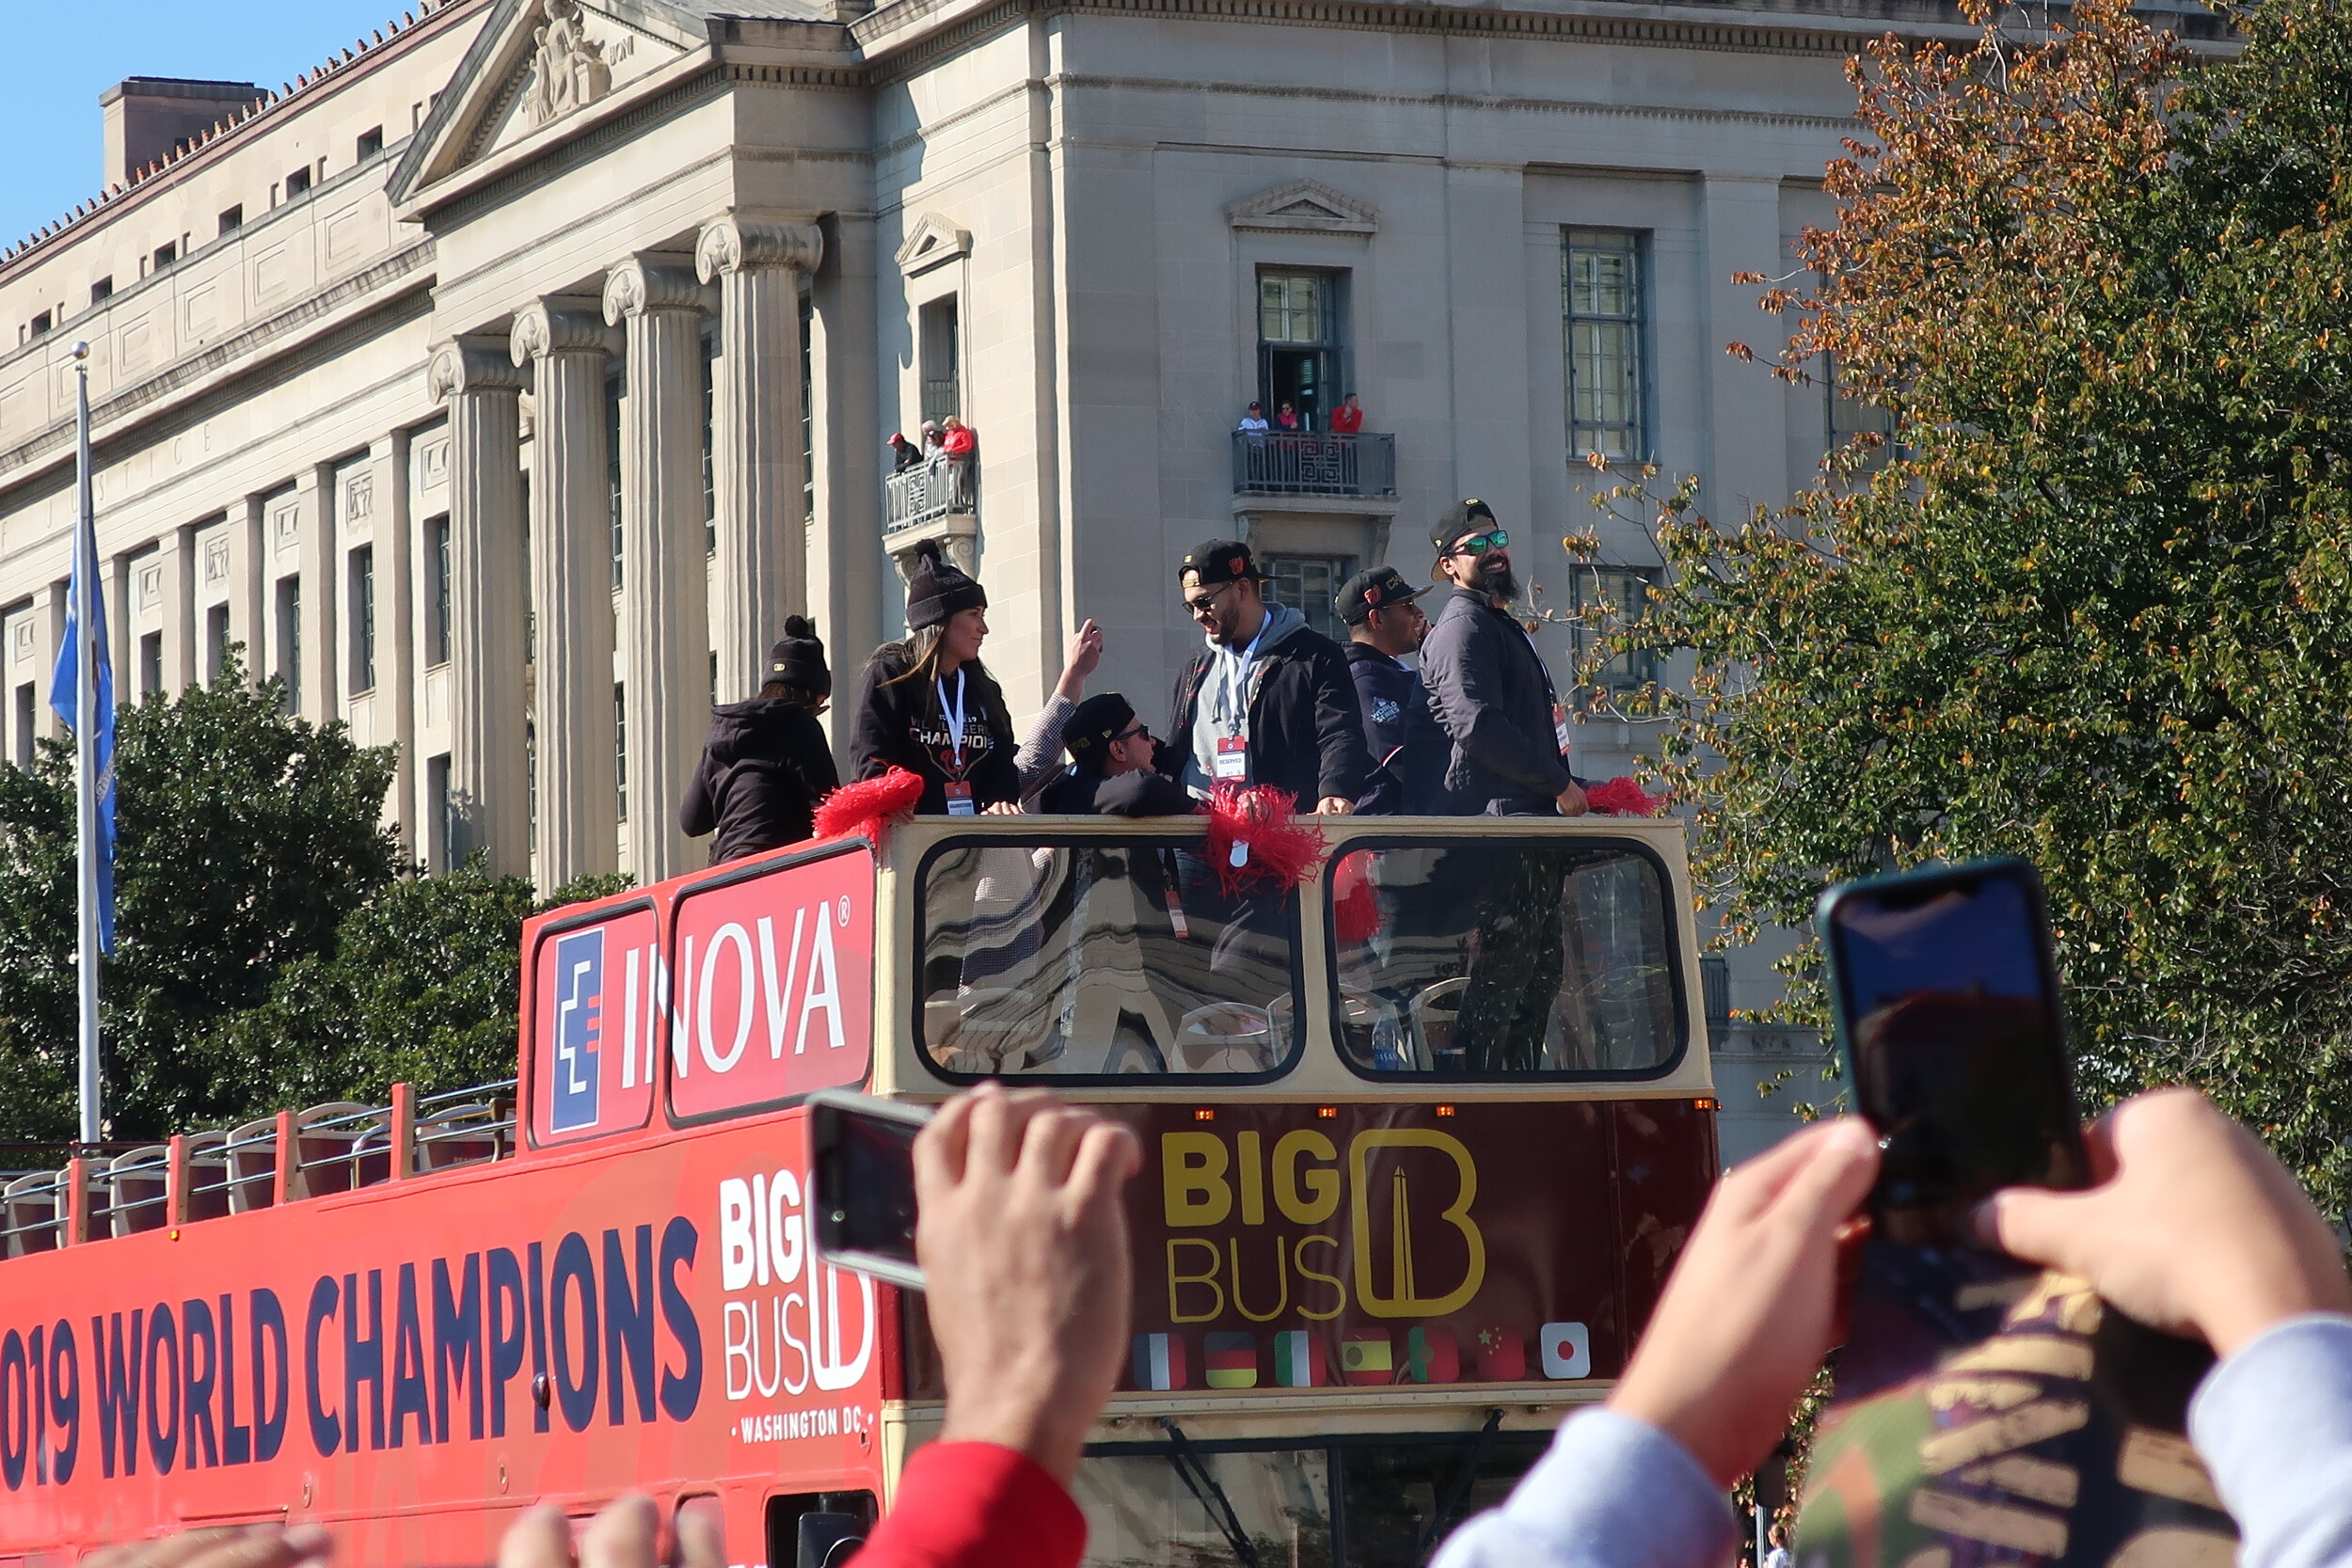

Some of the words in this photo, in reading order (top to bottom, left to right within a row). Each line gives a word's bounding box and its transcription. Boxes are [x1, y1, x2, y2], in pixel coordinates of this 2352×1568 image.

[47, 423, 212, 529] JUSTICE
[1371, 701, 1397, 718] WORLD
[1376, 706, 1400, 723] SERIES
[1161, 1129, 1342, 1227] BIG
[719, 1168, 803, 1292] BIG
[1166, 1234, 1347, 1324] BUS
[91, 1286, 289, 1480] WORLD
[305, 1215, 704, 1459] CHAMPIONS
[723, 1291, 810, 1401] BUS
[740, 1407, 838, 1445] WASHINGTON
[843, 1404, 862, 1435] DC
